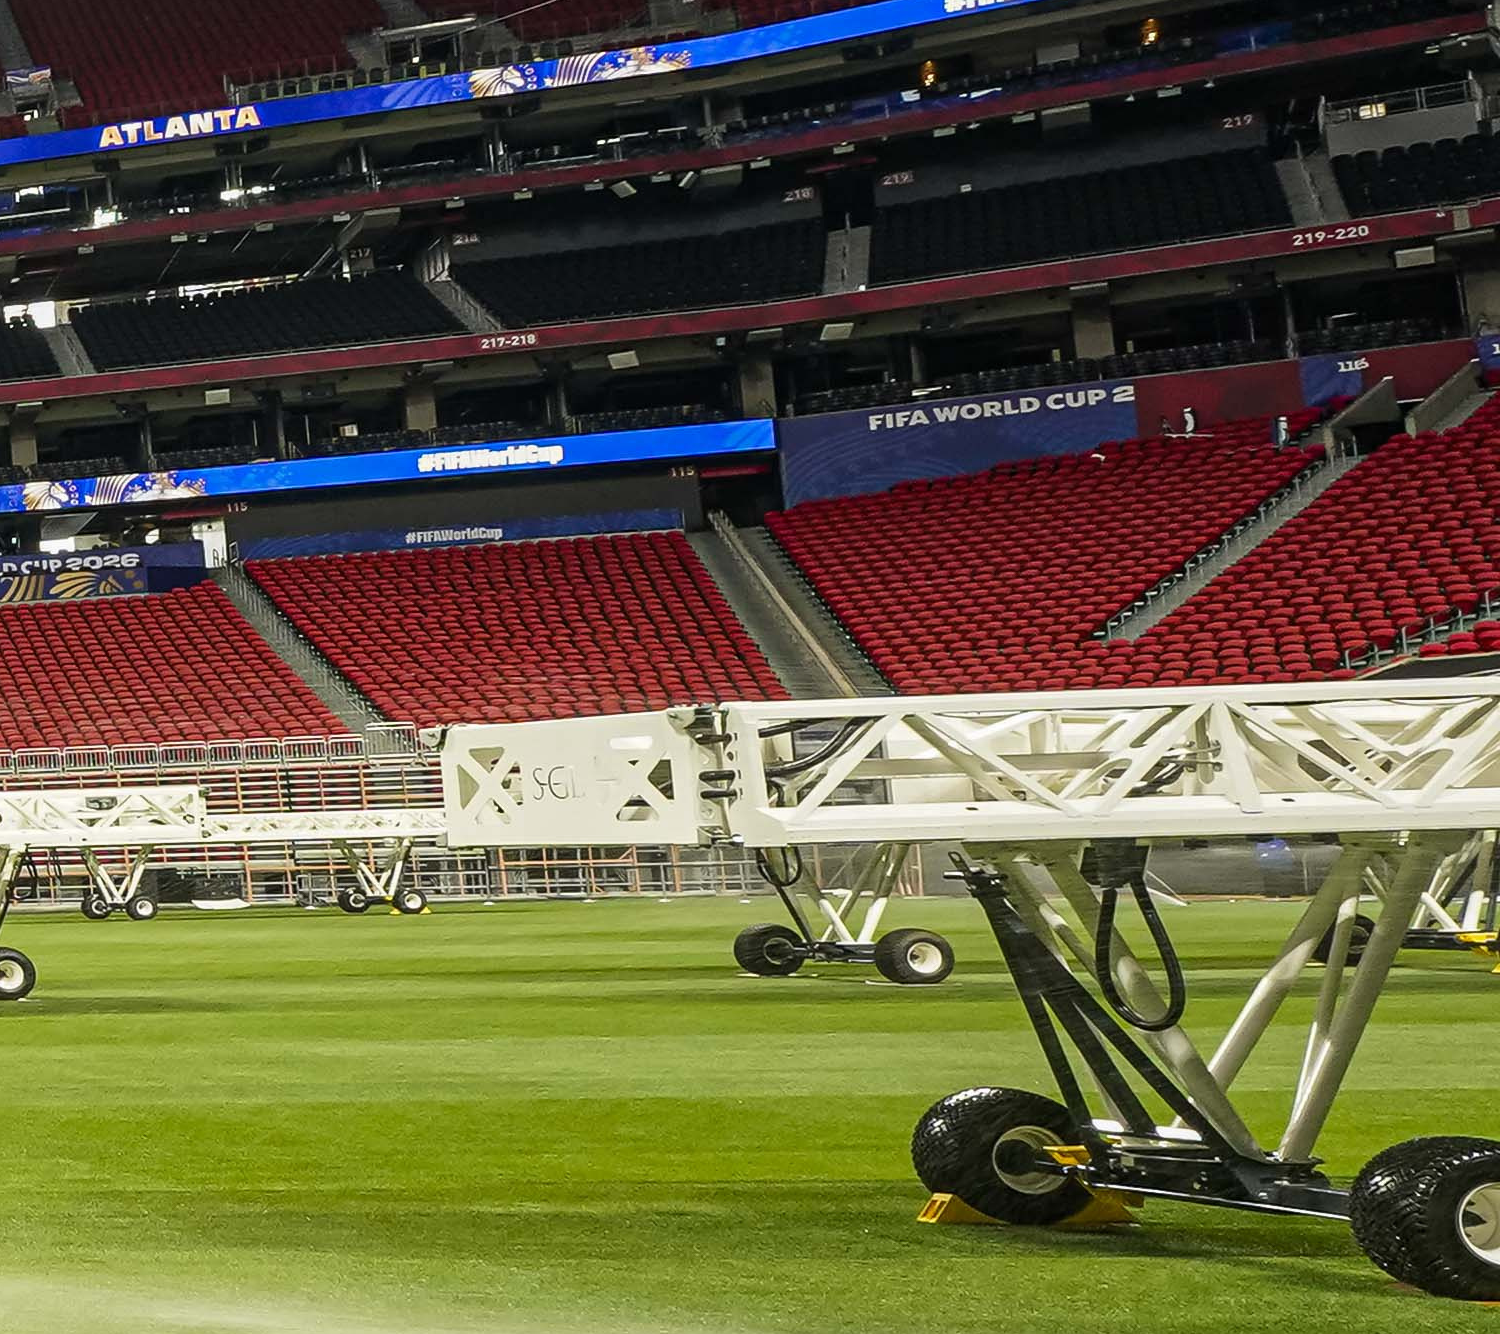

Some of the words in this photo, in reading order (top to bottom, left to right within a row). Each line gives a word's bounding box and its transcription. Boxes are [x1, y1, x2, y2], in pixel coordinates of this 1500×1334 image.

[99, 106, 261, 148] ATLANTA
[1222, 114, 1253, 129] 219
[881, 172, 910, 187] 219
[1293, 224, 1369, 246] 219-220
[480, 333, 536, 349] 217-218
[868, 409, 930, 431] FIFA
[933, 396, 1040, 422] WORLD
[1046, 388, 1107, 410] CUP
[417, 445, 564, 473] #FIFAWorldCup
[669, 466, 695, 478] 115
[226, 501, 248, 513] 115
[405, 526, 503, 544] #FIFAWorldCup
[65, 553, 140, 571] 2026
